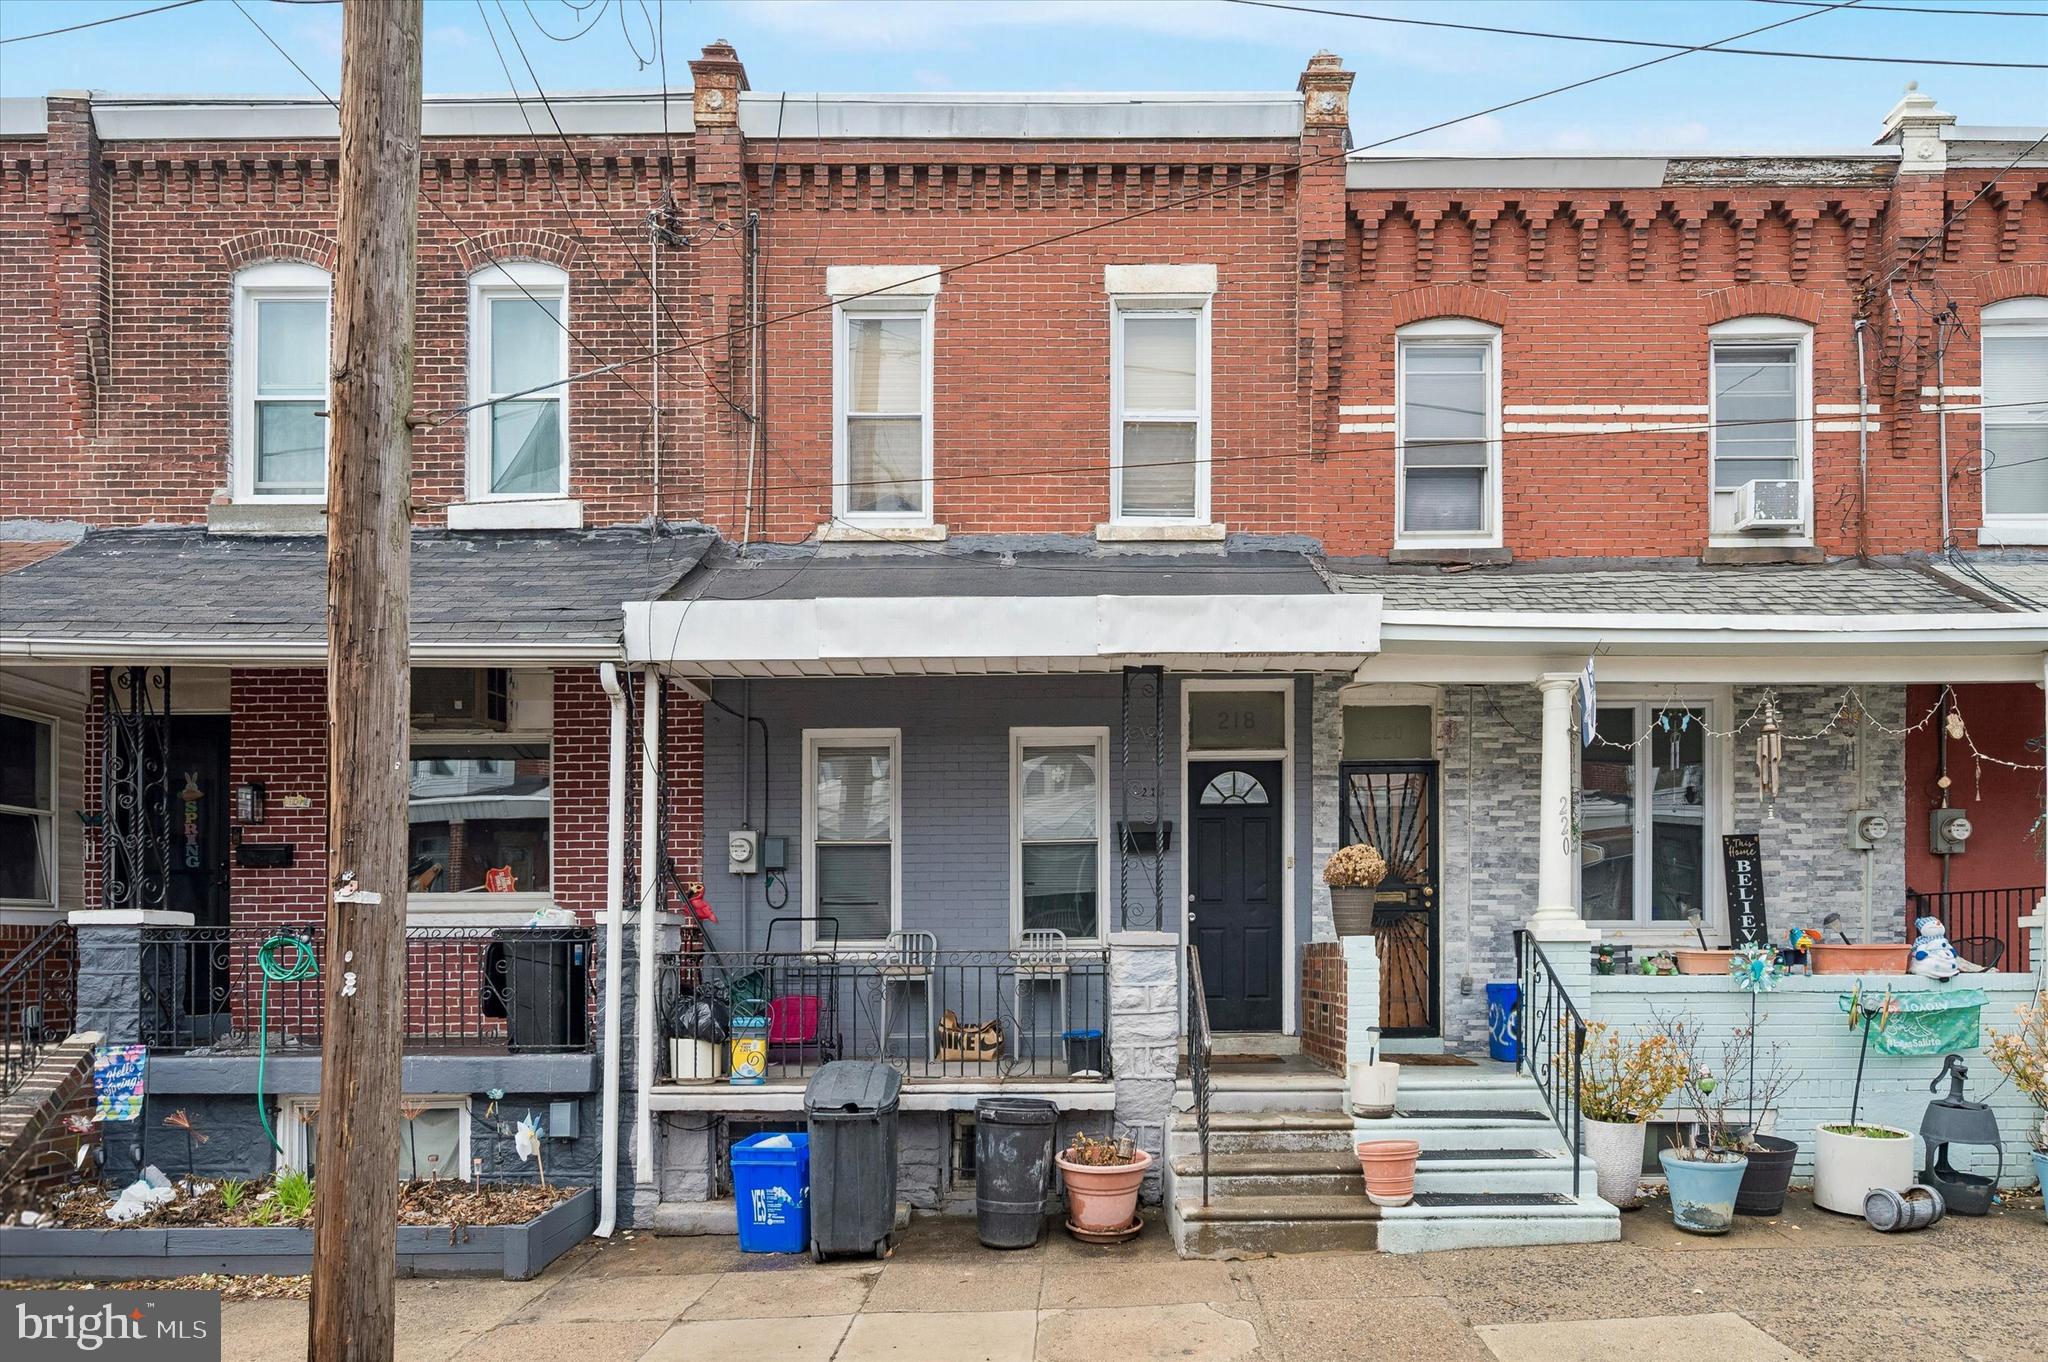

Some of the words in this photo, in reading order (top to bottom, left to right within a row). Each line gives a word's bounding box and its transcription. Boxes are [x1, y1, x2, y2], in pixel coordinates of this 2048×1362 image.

[1218, 712, 1256, 730] 218
[184, 800, 200, 868] SPRING
[1559, 796, 1570, 856] 220
[1728, 846, 1757, 858] Home
[1733, 838, 1755, 849] This
[106, 1063, 135, 1080] Hello
[751, 1189, 766, 1222] YES
